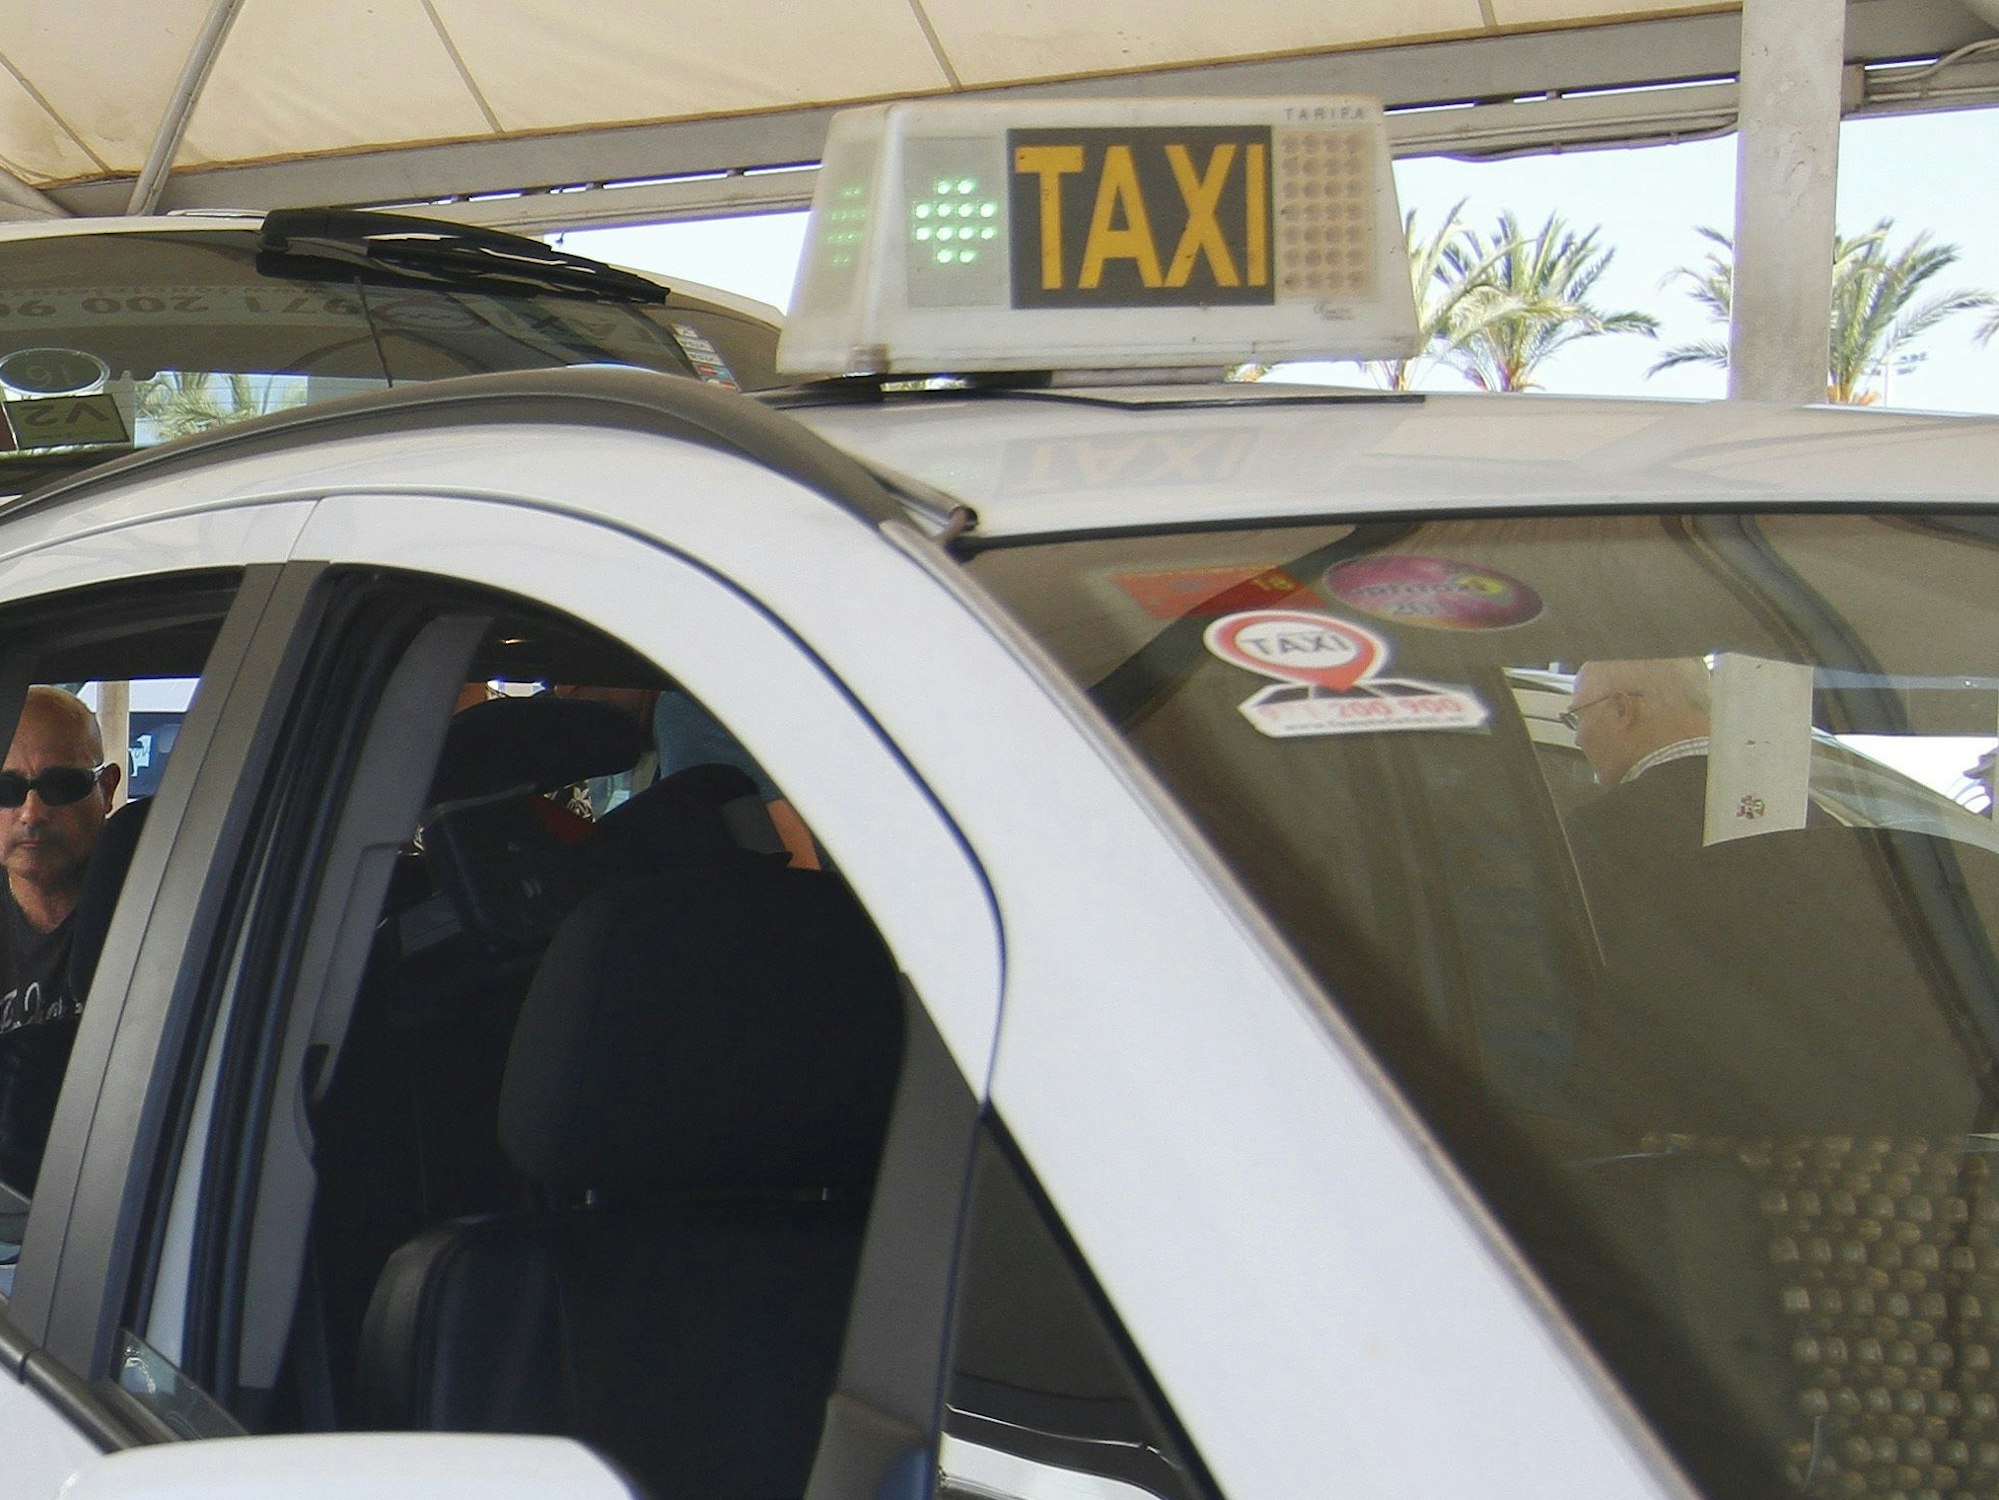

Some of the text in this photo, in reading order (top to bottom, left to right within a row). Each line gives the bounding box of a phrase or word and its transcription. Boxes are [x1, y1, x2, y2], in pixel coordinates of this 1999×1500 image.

[1285, 107, 1364, 121] TARIFA
[1015, 143, 1268, 289] TAXI
[0, 298, 57, 318] 9
[81, 296, 210, 315] 200
[19, 400, 111, 427] V2
[1243, 630, 1352, 655] TAXI
[1329, 699, 1395, 719] 200
